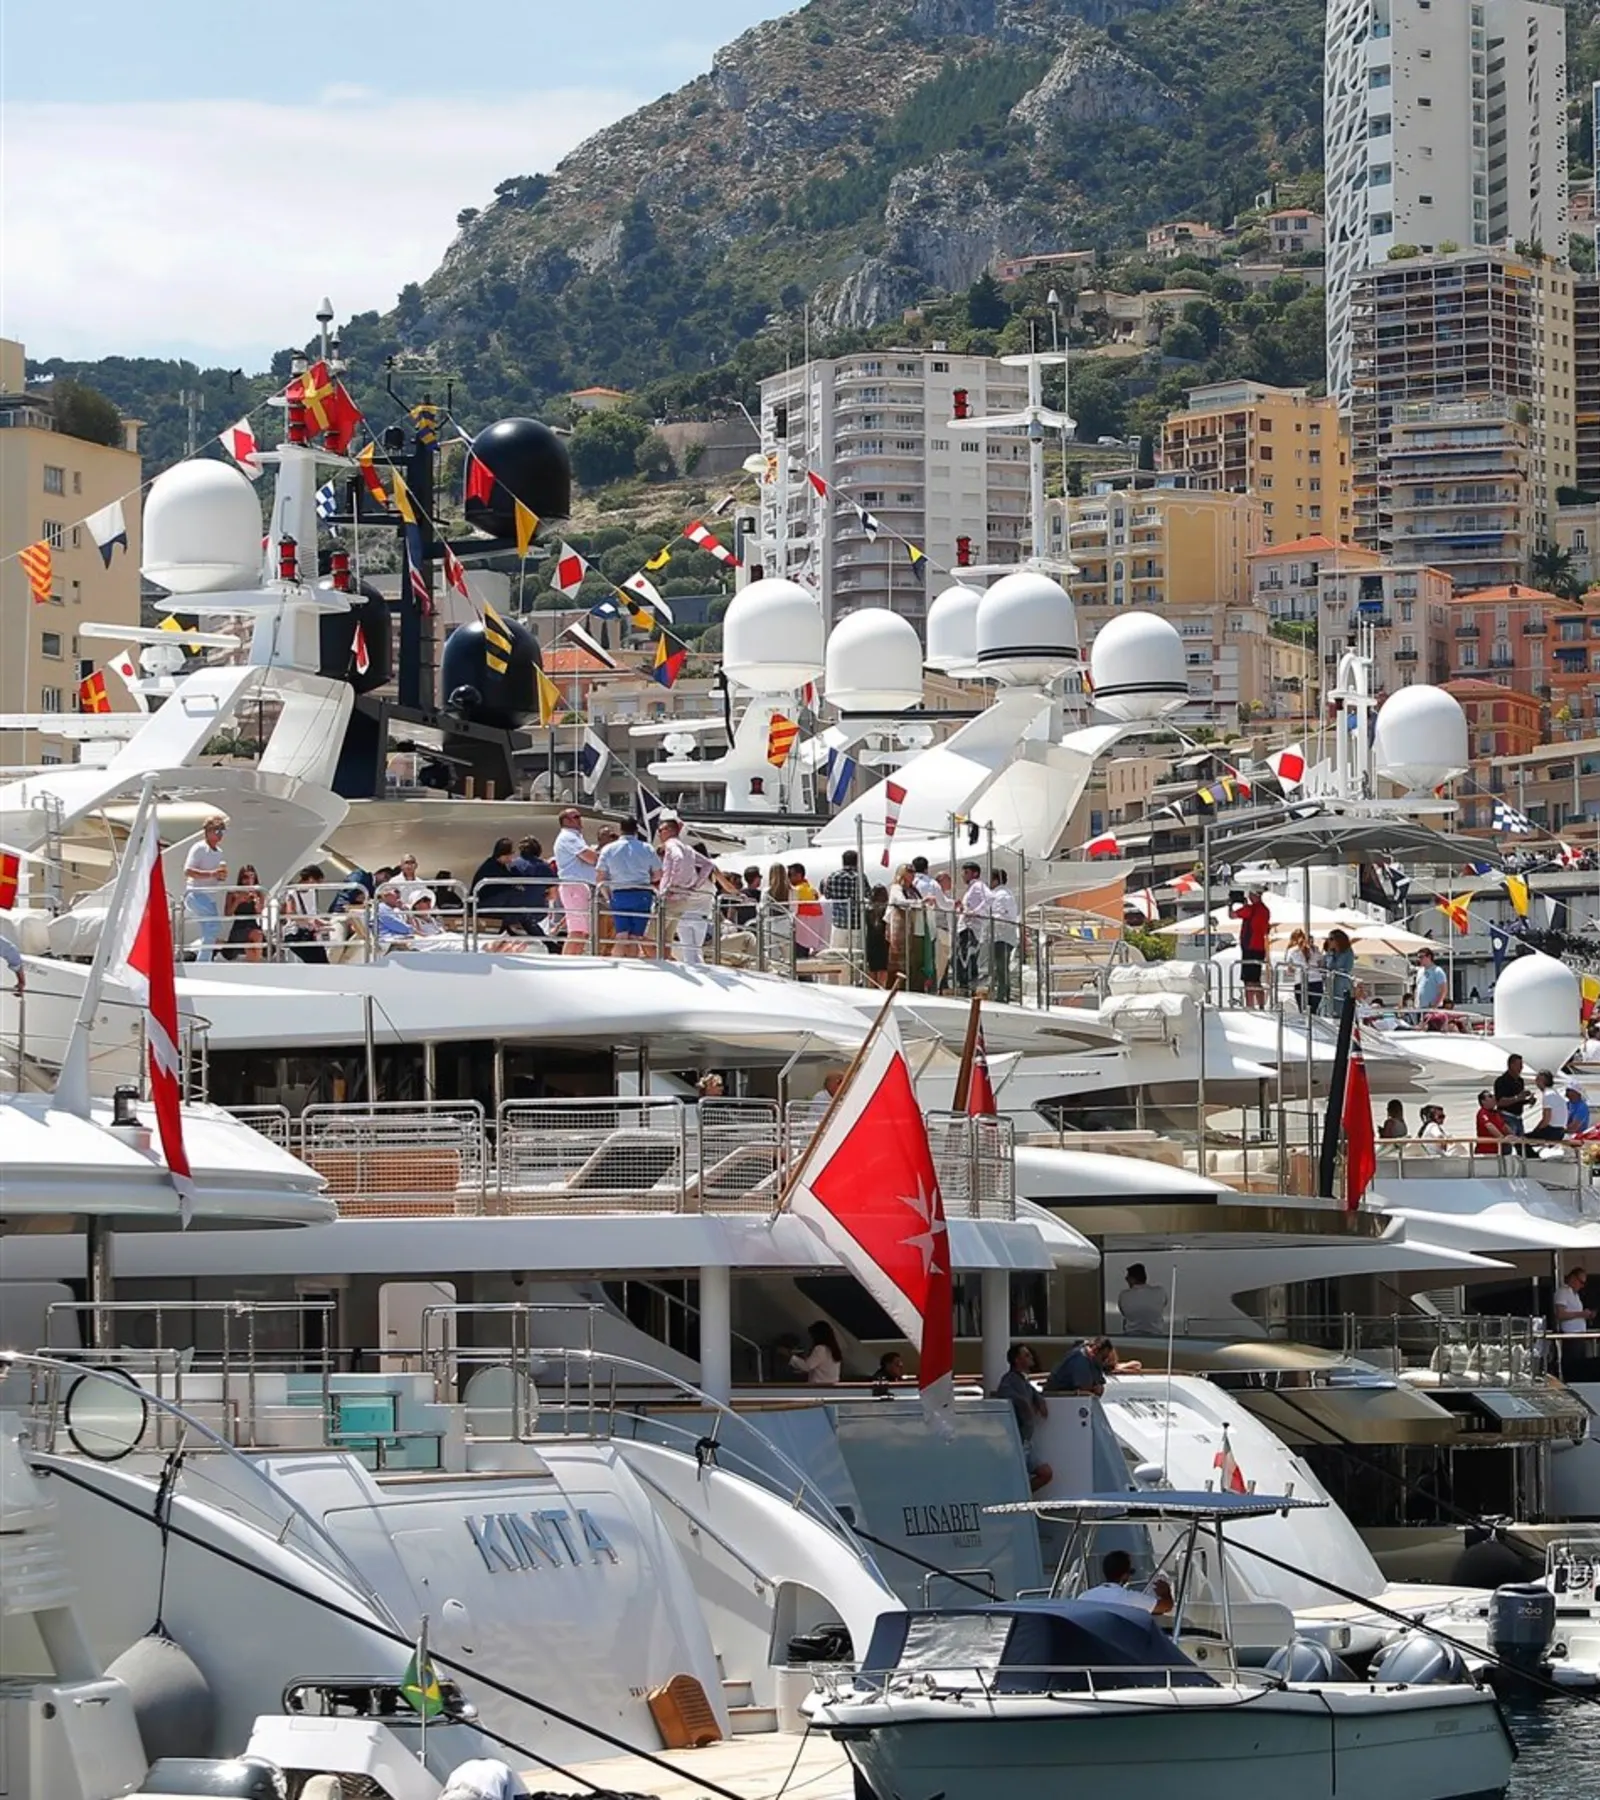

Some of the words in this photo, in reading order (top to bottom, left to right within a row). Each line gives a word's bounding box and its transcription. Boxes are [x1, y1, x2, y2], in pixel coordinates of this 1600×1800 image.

[902, 1502, 980, 1536] ELISABET
[462, 1507, 624, 1574] KINTA
[1517, 1606, 1543, 1616] 200
